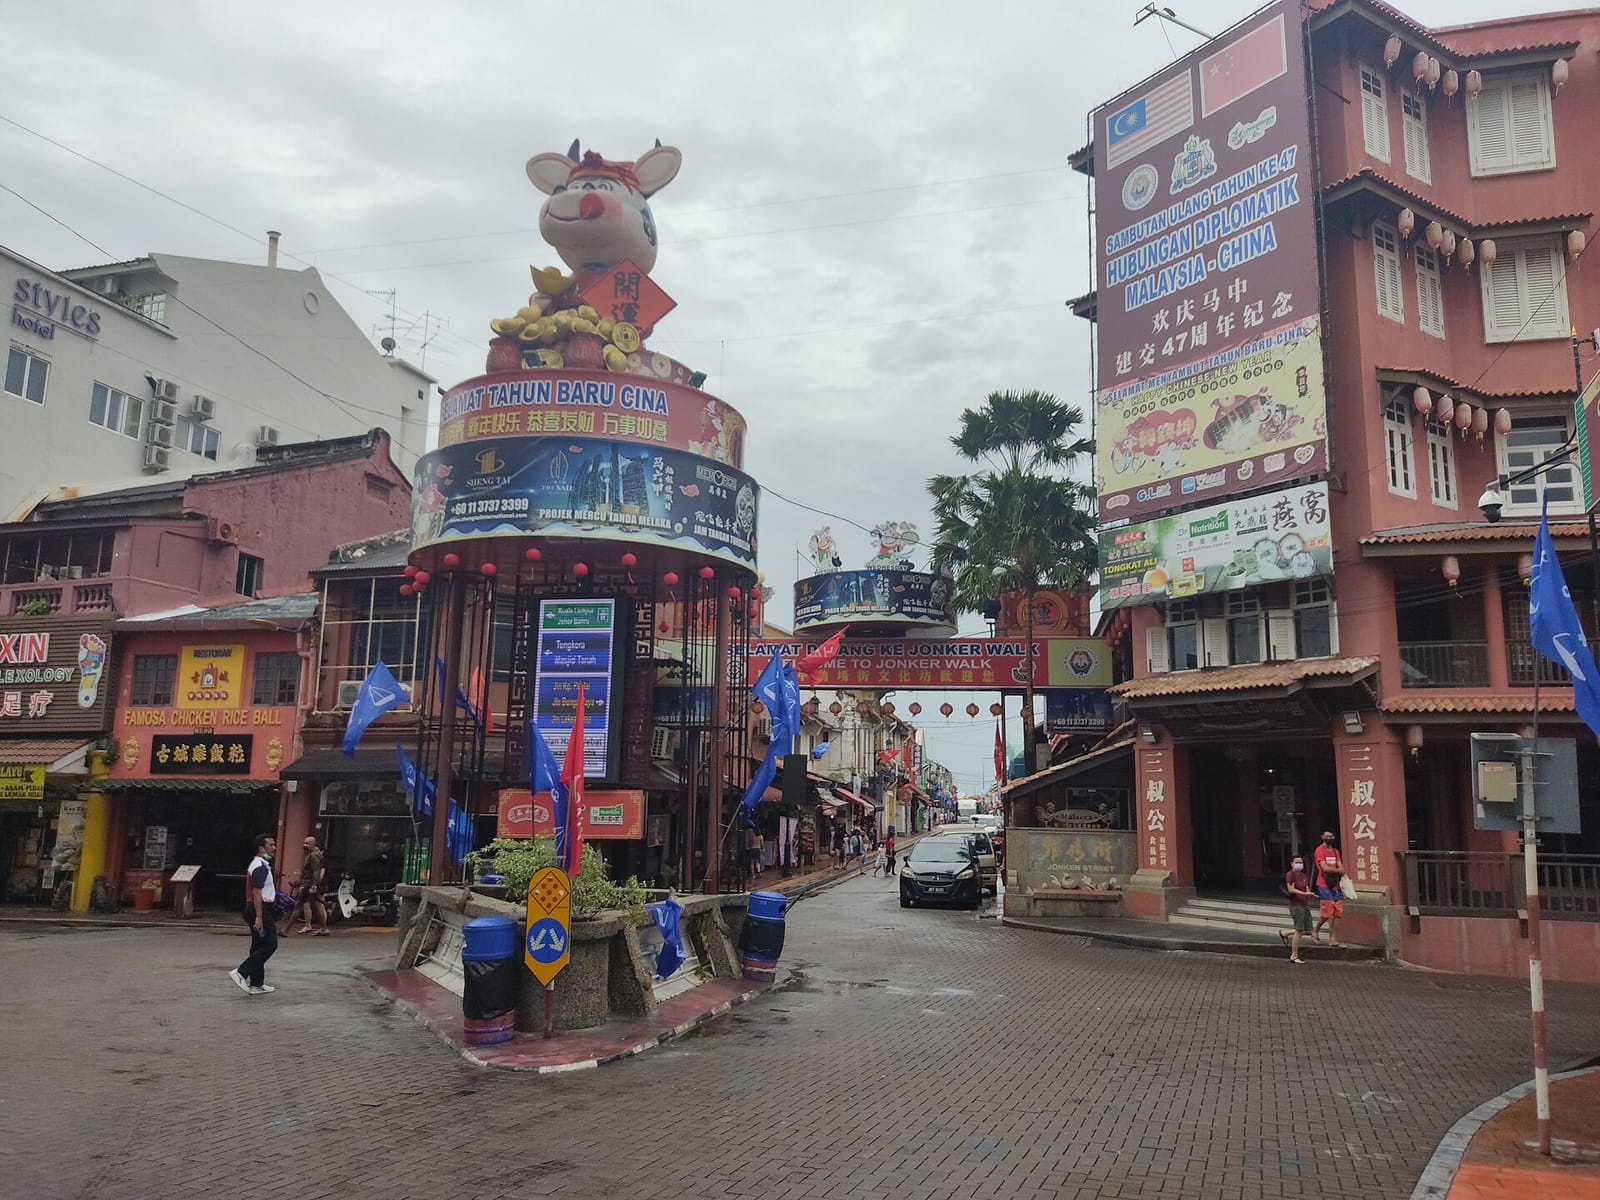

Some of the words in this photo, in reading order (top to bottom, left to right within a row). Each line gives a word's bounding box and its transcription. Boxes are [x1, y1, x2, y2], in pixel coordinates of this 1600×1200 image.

[1107, 213, 1167, 253] SAMBUTAN
[1169, 190, 1210, 224] ULANG
[1212, 166, 1256, 203] TAHUN
[1258, 155, 1278, 182] KE
[1281, 146, 1297, 170] 47
[1107, 226, 1191, 286] HUBUNGAN
[1194, 177, 1298, 246] DIPLOMATIK
[1126, 256, 1205, 310] MALAYSIA
[1219, 223, 1276, 270] CHINA
[12, 306, 55, 340] hotel
[14, 278, 101, 335] styles
[1152, 277, 1248, 334] 欢庆马中
[1115, 291, 1293, 376] 建交47周年纪念
[1107, 381, 1145, 402] SELAMAT
[1148, 360, 1205, 389] MENYAMBUT
[1208, 347, 1241, 369] TAHUN
[1244, 337, 1273, 356] BARU
[1276, 326, 1304, 345] CINA
[1166, 371, 1210, 394] CHINESE
[1213, 361, 1239, 380] NEW
[1241, 350, 1273, 369] YEAR
[440, 386, 486, 424] SELAMAT
[488, 380, 552, 408] TAHUN
[556, 380, 616, 408] BARU
[619, 384, 670, 416] CINA
[467, 411, 522, 437] 新年快乐
[527, 410, 596, 434] 恭喜发财
[602, 411, 668, 442] 万事如意
[652, 457, 664, 497] 马六甲
[477, 499, 499, 512] 3737
[501, 498, 529, 511] 3399
[539, 508, 573, 520] PROJEK
[574, 510, 607, 522] MERCU
[608, 512, 638, 525] TANDA
[638, 515, 672, 529] MELAKA
[1178, 528, 1188, 537] Dr
[1191, 520, 1225, 535] Nutrition
[1103, 560, 1141, 575] TONGKAT
[1143, 557, 1158, 567] ALI
[0, 633, 50, 663] XIN
[727, 642, 802, 657] SELAMAT
[880, 643, 905, 656] KE
[909, 643, 982, 657] JONKER
[986, 643, 1040, 657] WALK
[852, 659, 872, 669] TO
[876, 658, 941, 669] JONKER
[945, 658, 992, 669] WALK
[0, 690, 54, 718] 足疗
[124, 710, 166, 726] FAMOSA
[170, 709, 218, 726] CHICKEN
[222, 709, 249, 725] RICE
[252, 709, 282, 726] BALL
[1144, 751, 1167, 832] 三叔公
[1348, 746, 1378, 841] 三叔公
[1047, 863, 1081, 872] JONKER
[1082, 864, 1115, 873] STREET
